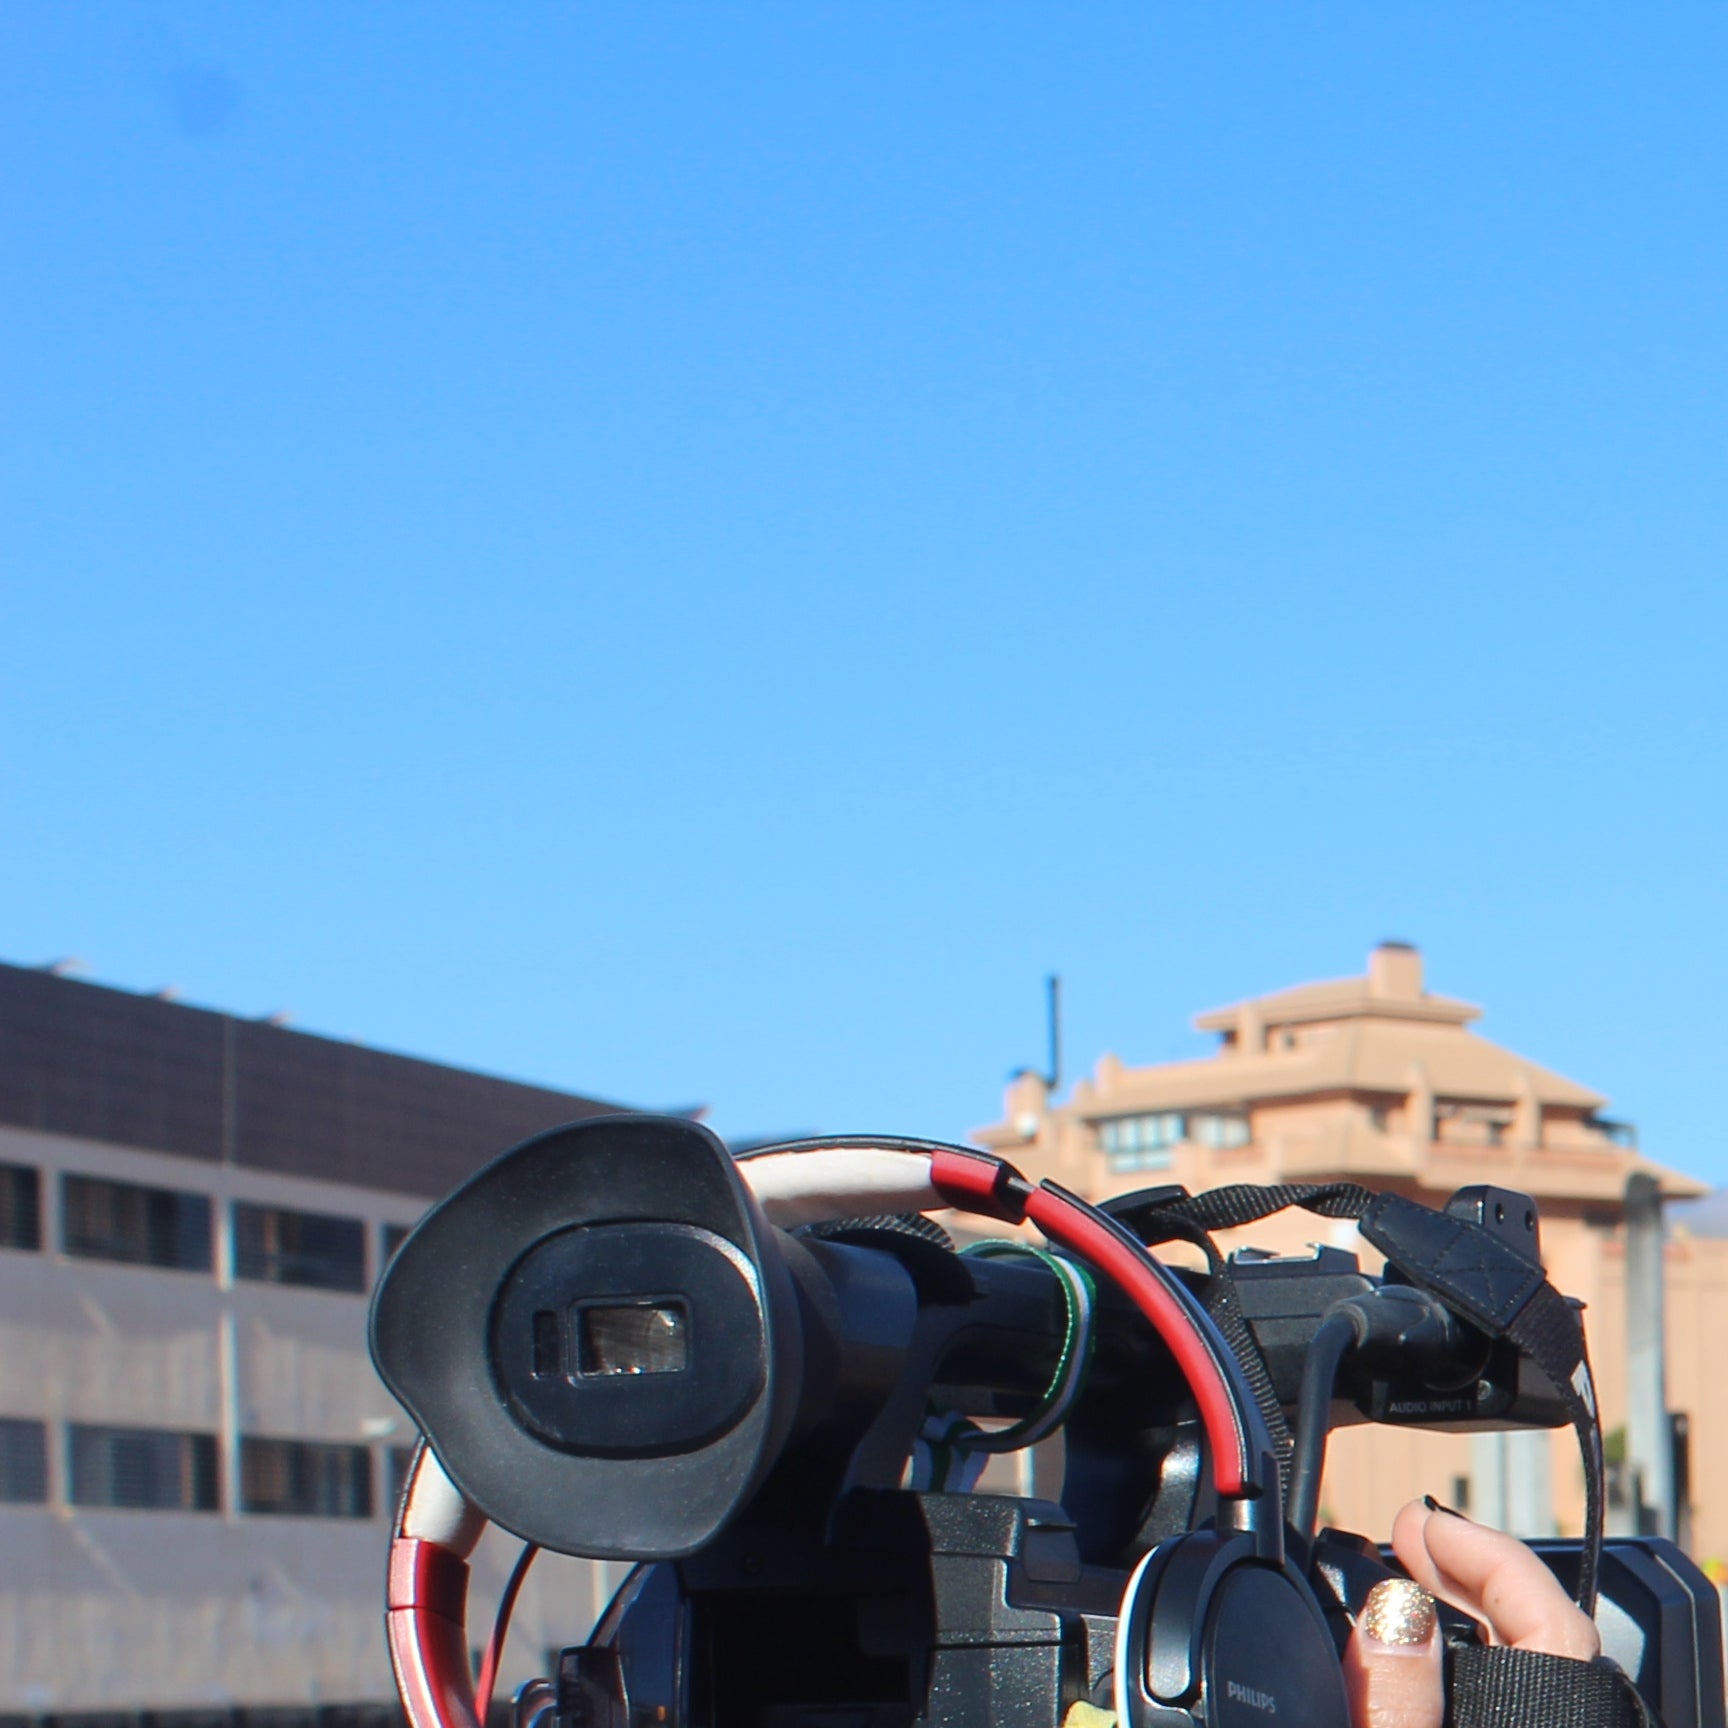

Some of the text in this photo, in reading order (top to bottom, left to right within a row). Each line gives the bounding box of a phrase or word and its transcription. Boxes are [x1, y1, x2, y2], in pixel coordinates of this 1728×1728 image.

[1389, 1402, 1427, 1414] AUDIO
[1429, 1401, 1462, 1412] INPUT
[1227, 1680, 1276, 1714] PHILIPS
